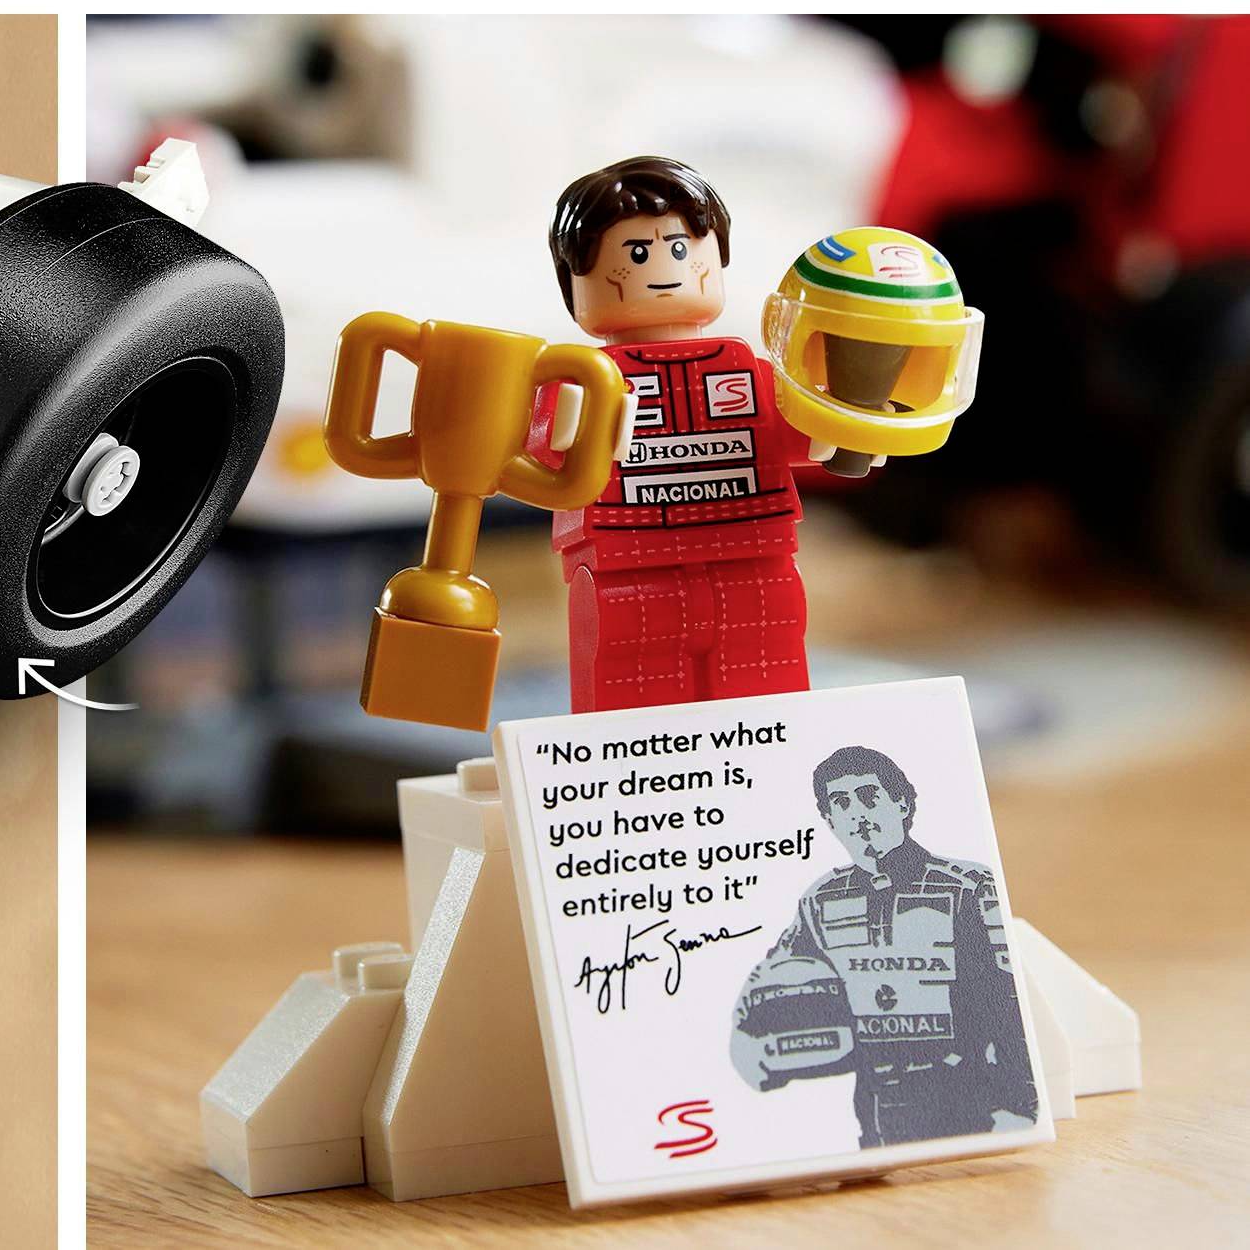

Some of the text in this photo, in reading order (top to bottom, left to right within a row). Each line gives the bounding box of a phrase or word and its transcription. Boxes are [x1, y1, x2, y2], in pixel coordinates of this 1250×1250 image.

[649, 440, 750, 460] HONDA
[642, 481, 745, 503] NACIONAL
[602, 733, 703, 761] matter
[710, 722, 786, 748] what
[543, 761, 753, 809] your dream is,
[549, 806, 725, 847] you have to
[556, 828, 815, 879] dedicate yourself
[562, 884, 672, 917] entirely
[683, 883, 713, 904] to
[849, 957, 950, 972] HONDA
